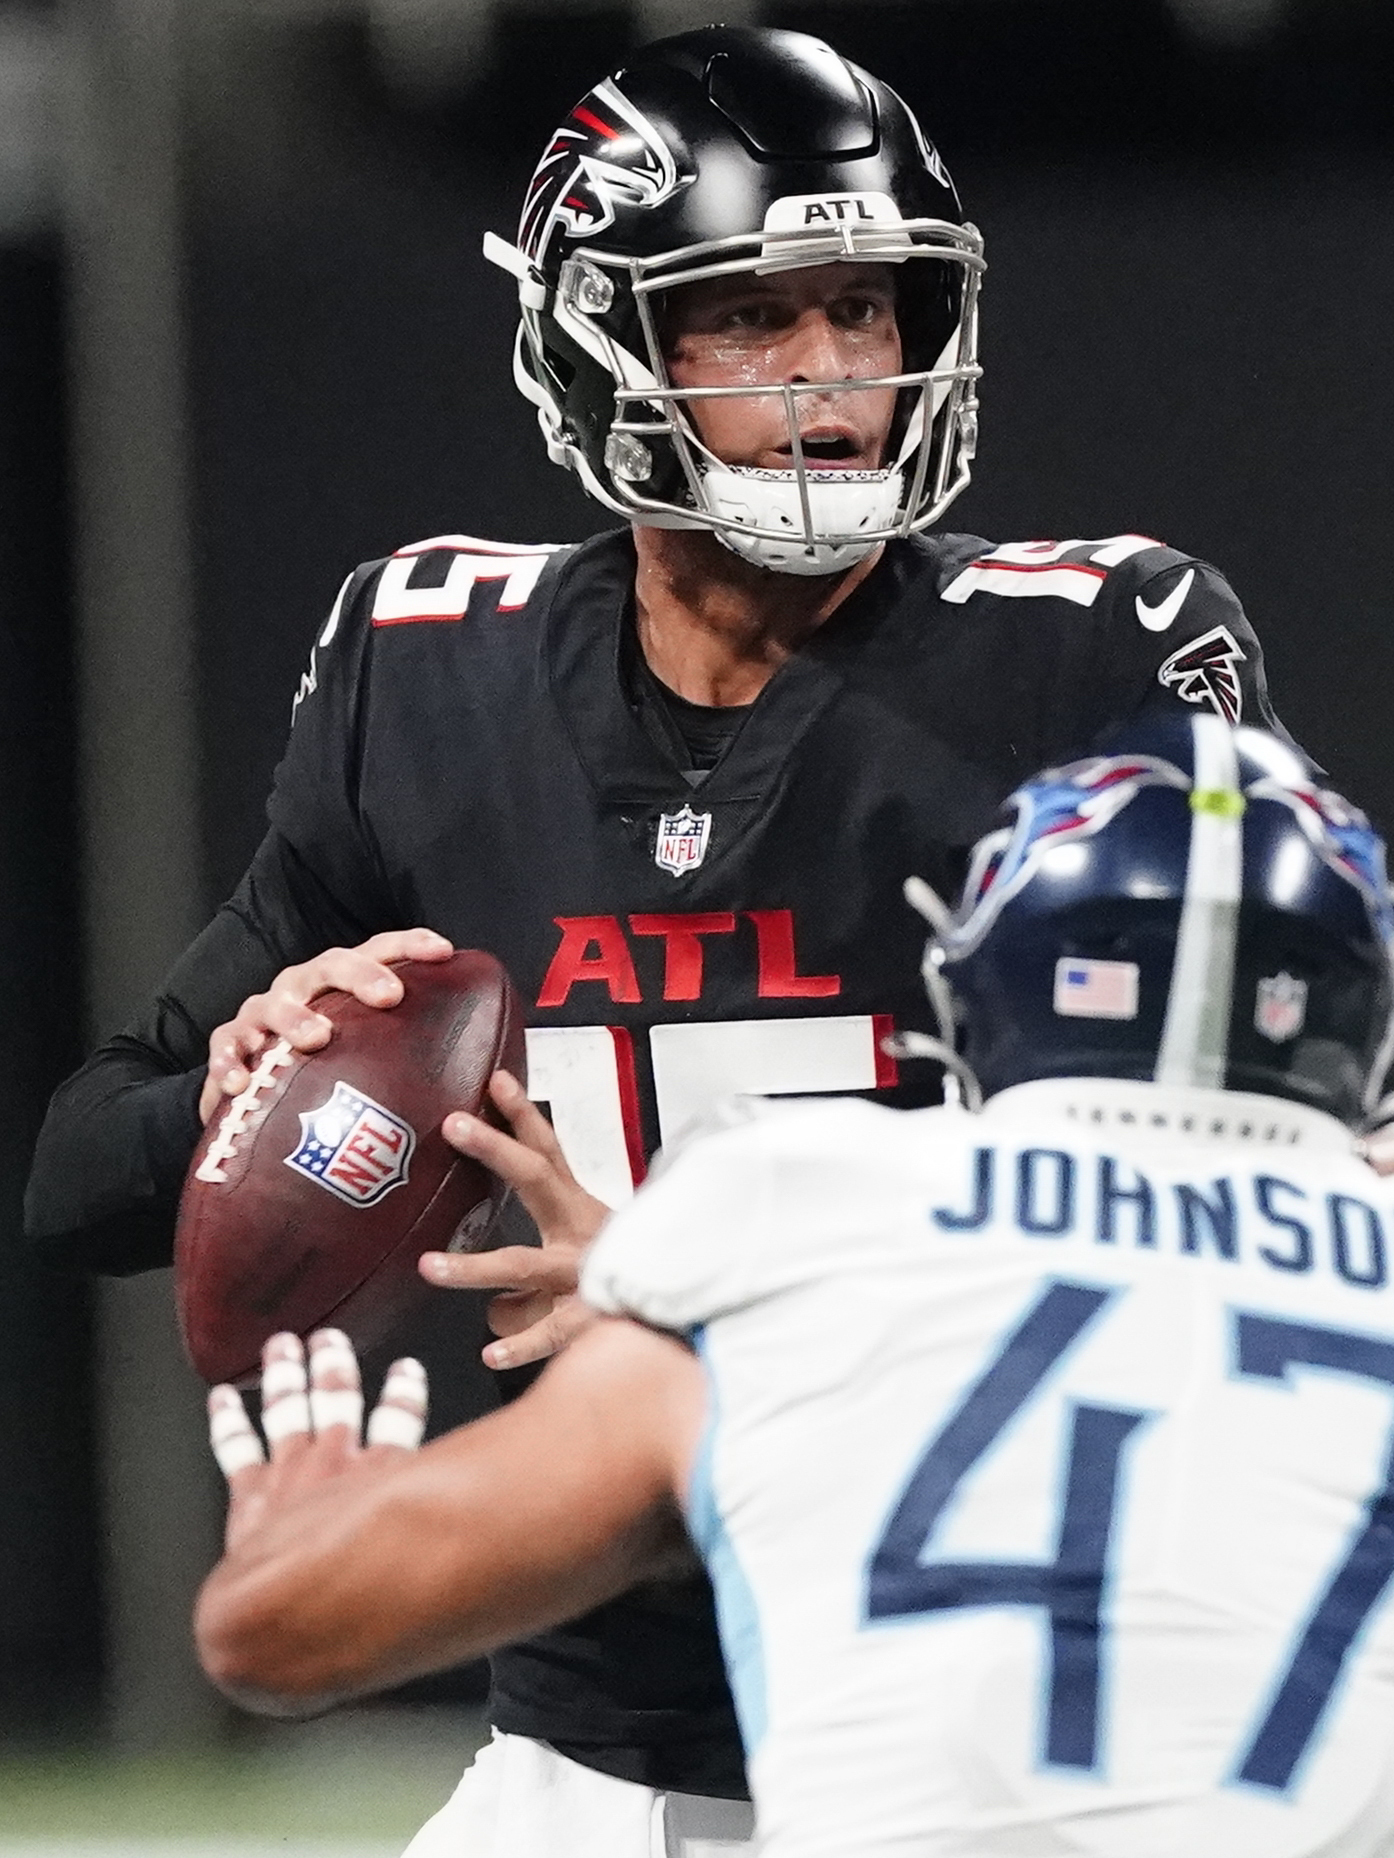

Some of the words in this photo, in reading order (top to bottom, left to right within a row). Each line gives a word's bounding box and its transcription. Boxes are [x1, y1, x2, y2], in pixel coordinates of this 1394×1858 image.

[803, 200, 874, 224] ATL
[664, 838, 697, 863] NFL
[536, 909, 841, 1008] ATL
[329, 1122, 402, 1196] NFL
